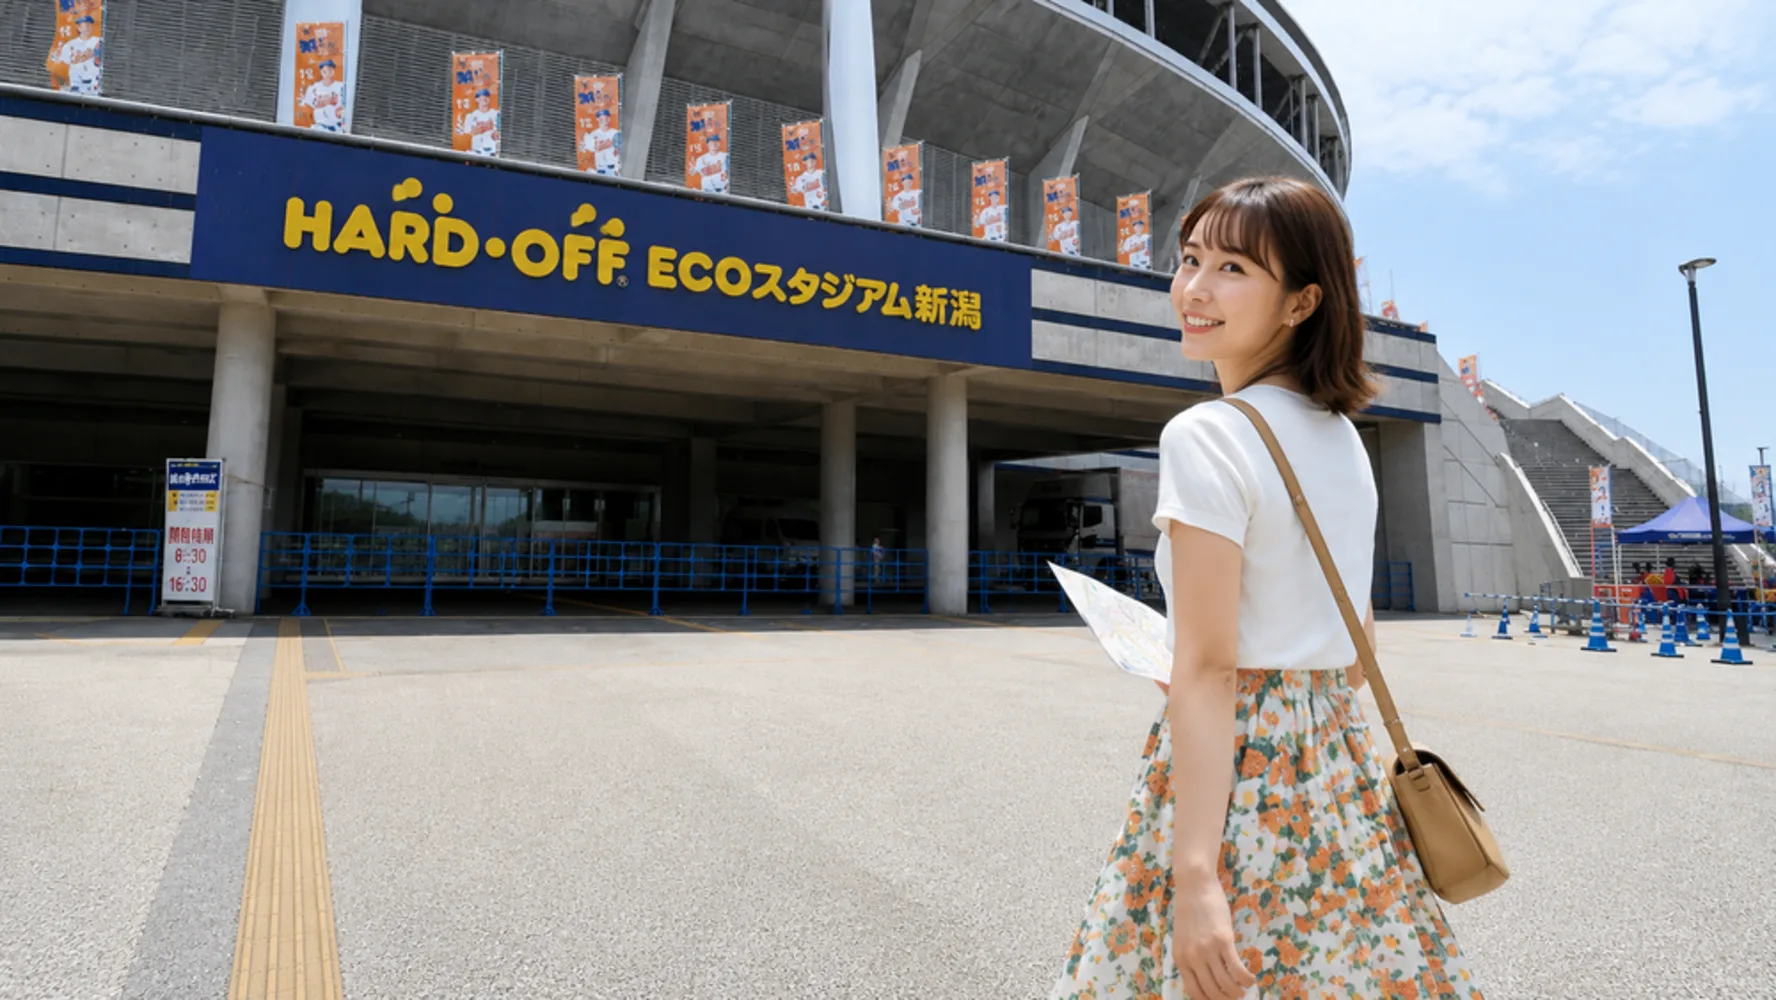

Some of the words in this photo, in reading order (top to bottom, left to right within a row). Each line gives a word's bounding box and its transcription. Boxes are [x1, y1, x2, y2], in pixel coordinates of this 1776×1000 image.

[647, 245, 982, 330] ECOスタジアム新潟
